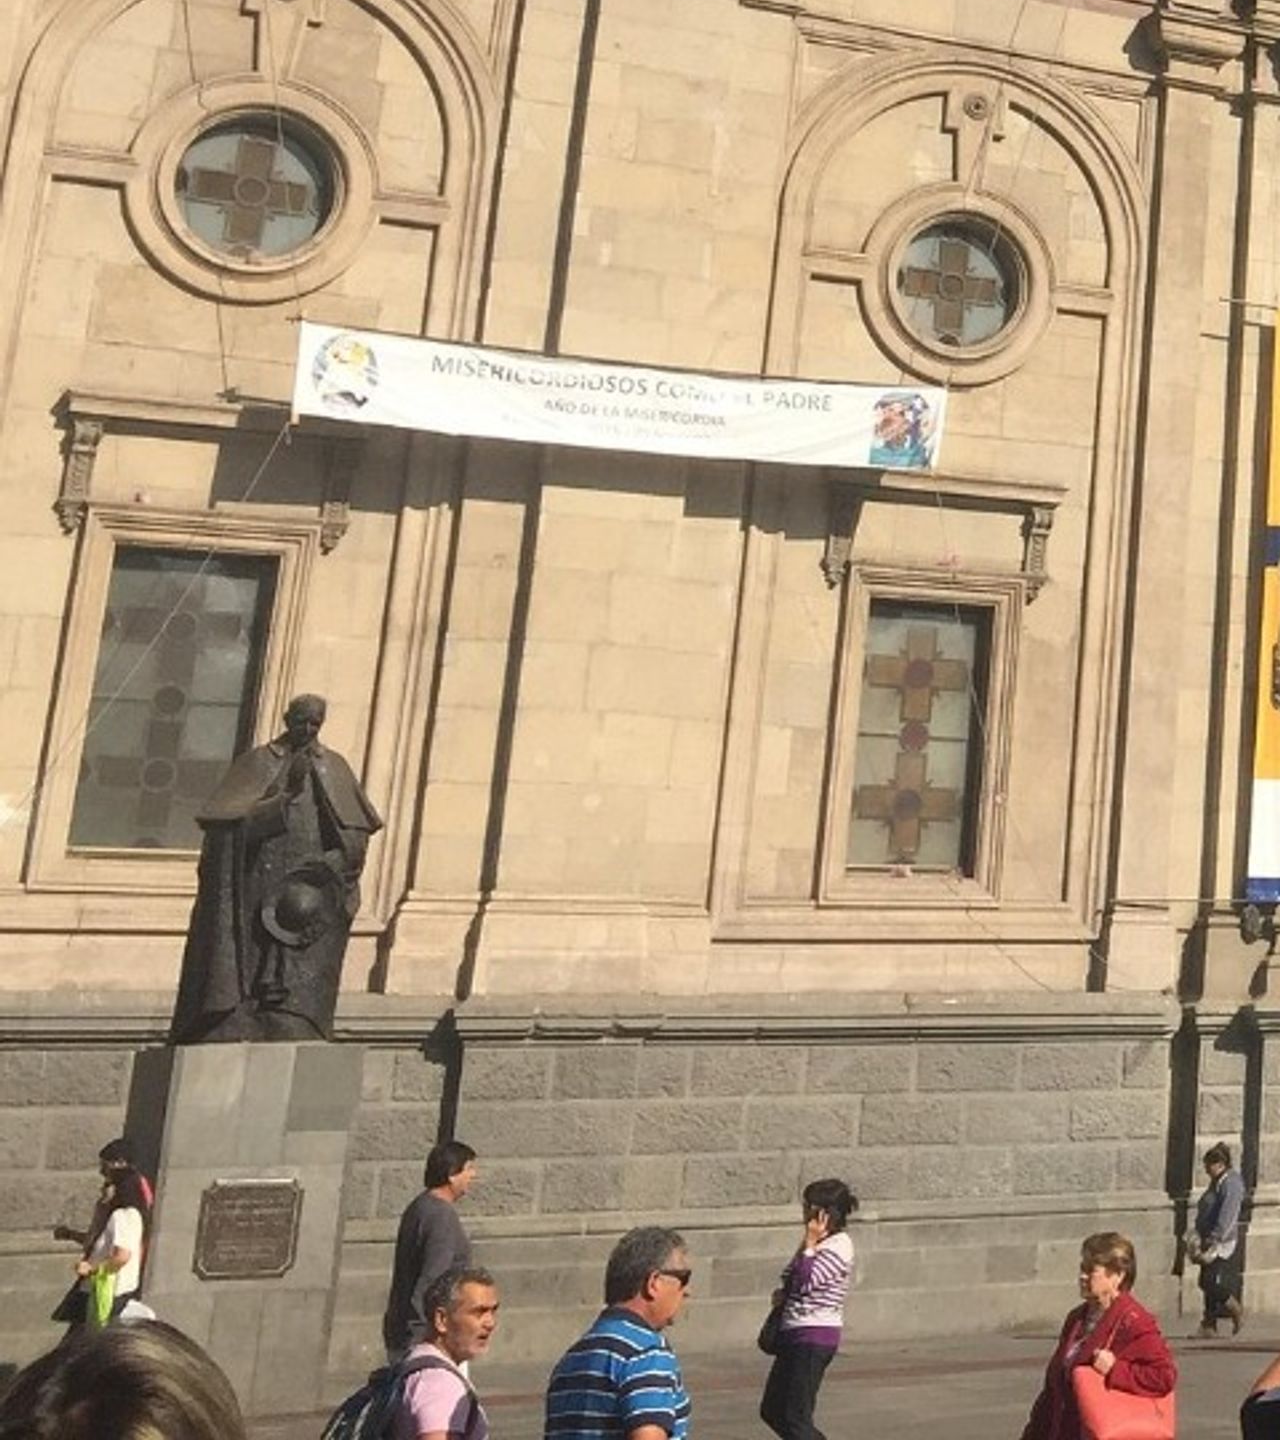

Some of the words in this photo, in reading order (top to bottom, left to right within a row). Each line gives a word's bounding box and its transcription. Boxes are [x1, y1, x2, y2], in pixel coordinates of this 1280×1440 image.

[431, 354, 648, 397] MISERICORDIOSOS
[762, 391, 834, 412] PADRE
[543, 398, 576, 415] AÑO
[579, 401, 600, 417] DE
[602, 403, 621, 418] LA
